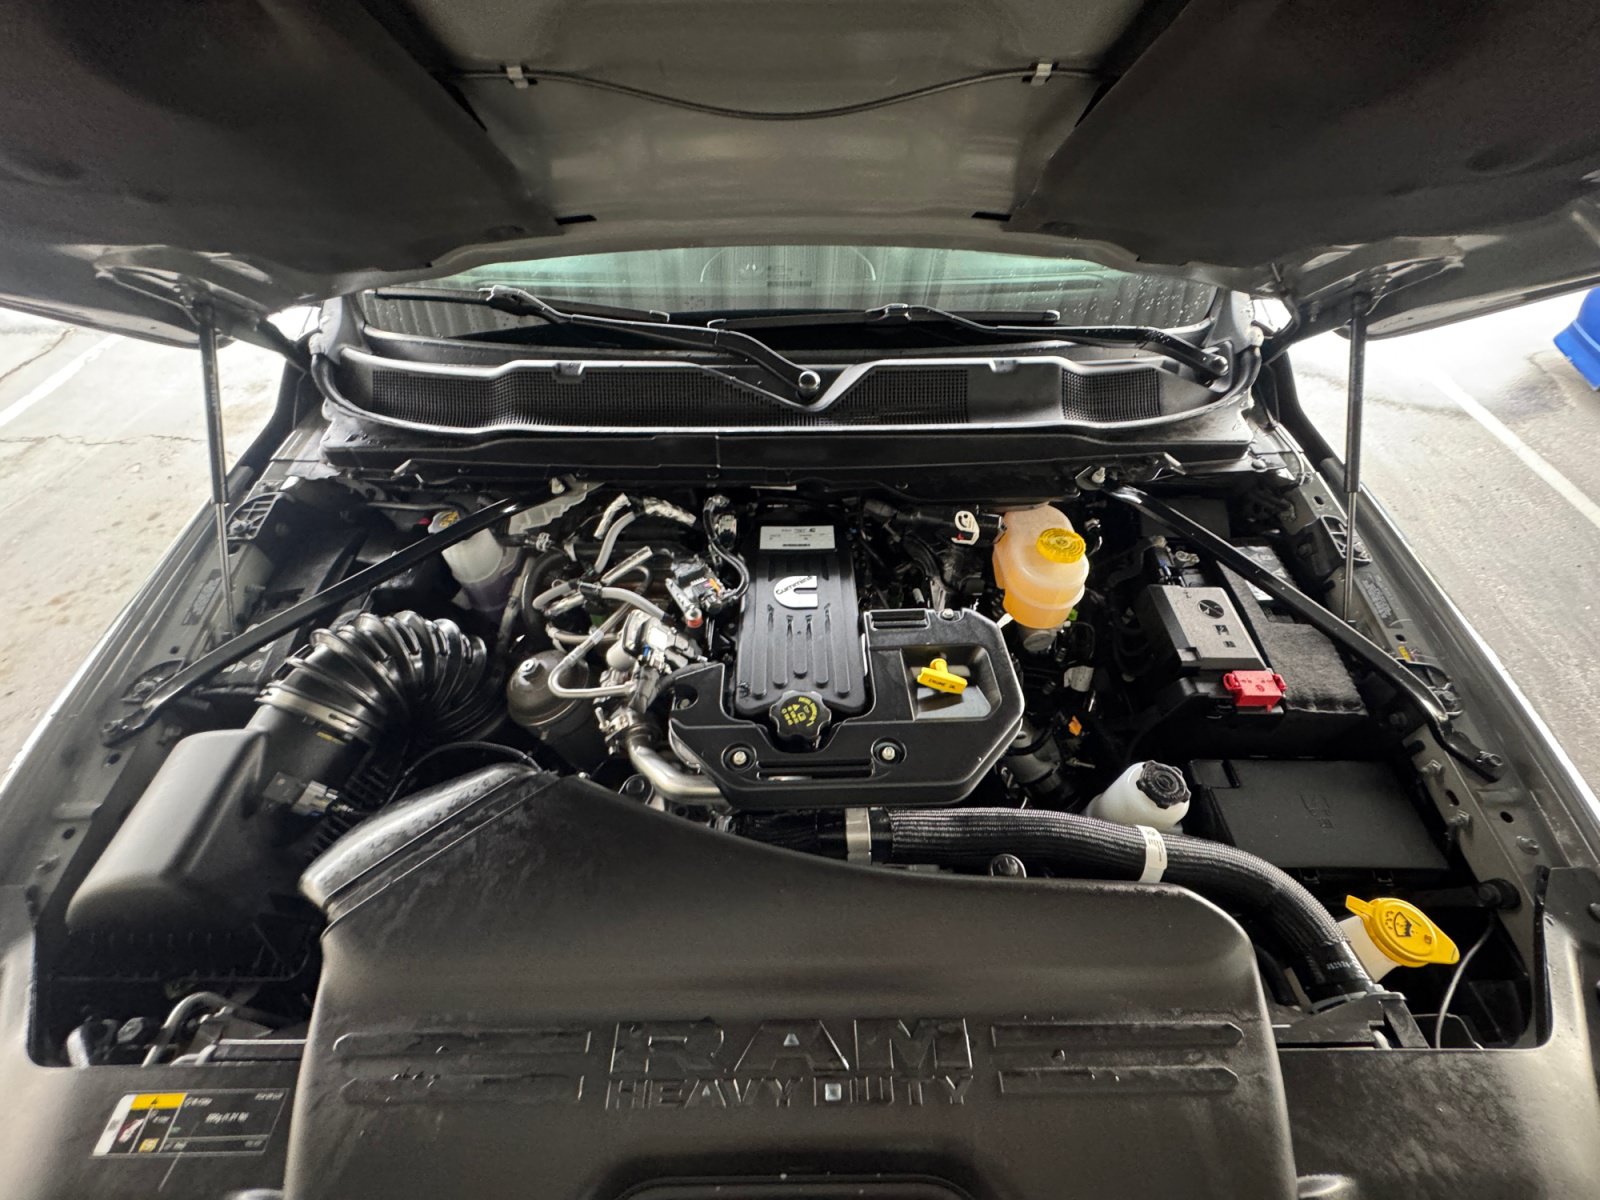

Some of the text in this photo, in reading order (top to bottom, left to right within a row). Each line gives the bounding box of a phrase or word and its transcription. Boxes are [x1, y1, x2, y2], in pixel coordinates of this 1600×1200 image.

[776, 575, 813, 595] Cummins
[609, 1018, 973, 1072] RAM
[605, 1076, 974, 1109] HEAVY DUTY
